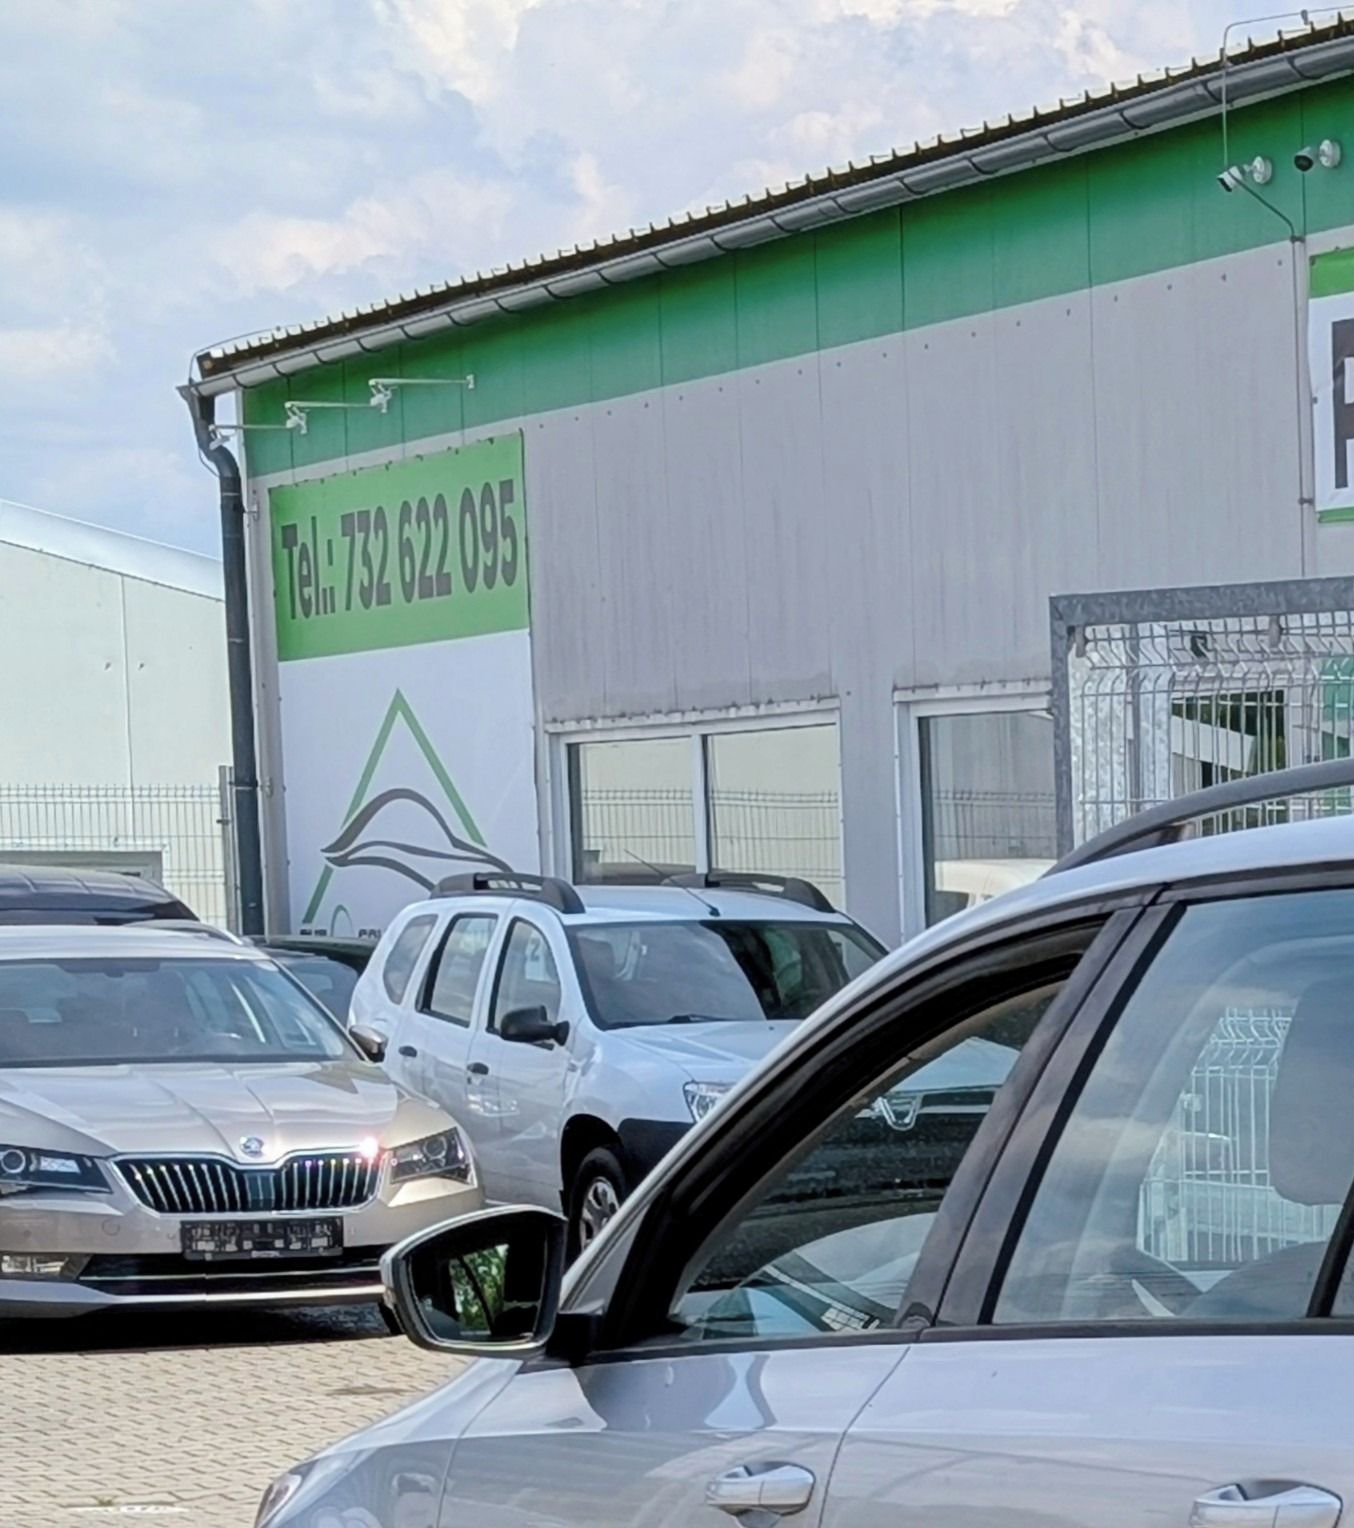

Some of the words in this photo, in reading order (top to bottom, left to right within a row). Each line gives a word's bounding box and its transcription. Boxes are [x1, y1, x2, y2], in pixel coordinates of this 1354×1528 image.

[281, 516, 336, 620] Tel.:
[341, 505, 392, 612] 732
[398, 492, 452, 604] 622
[459, 478, 518, 593] 095
